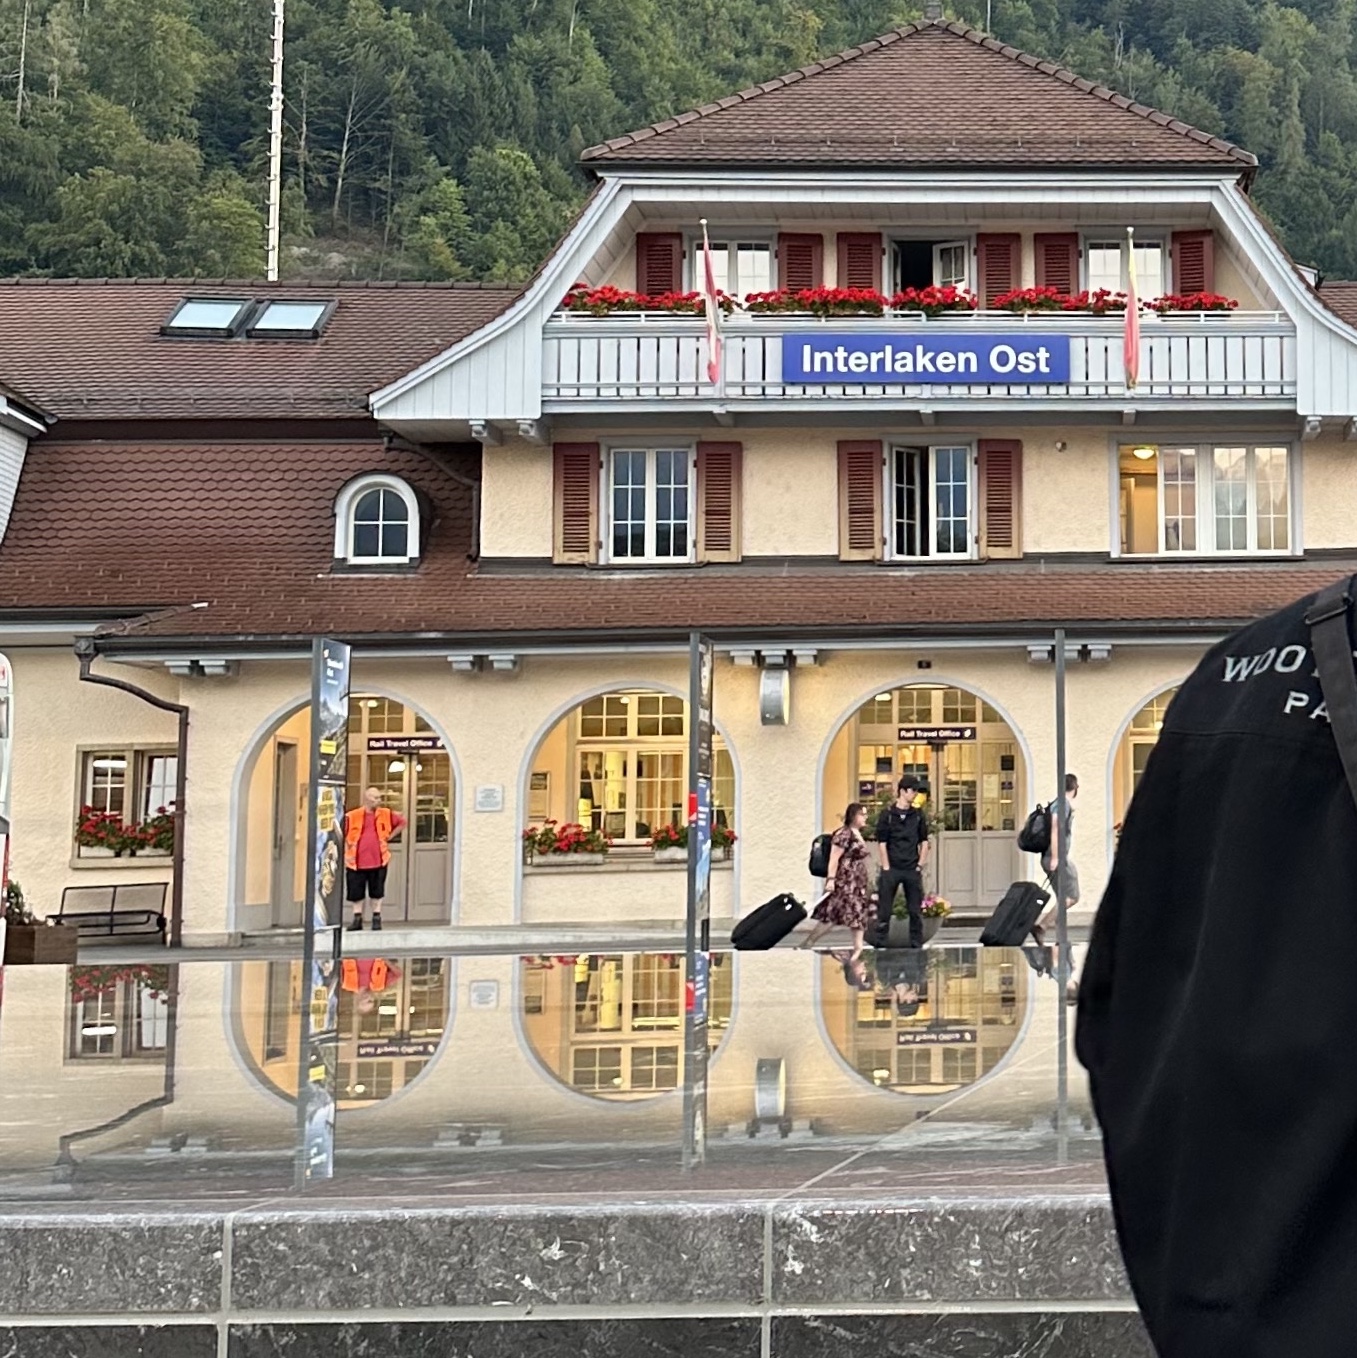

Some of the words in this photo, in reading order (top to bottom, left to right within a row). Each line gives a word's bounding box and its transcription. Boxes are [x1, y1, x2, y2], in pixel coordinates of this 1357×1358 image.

[802, 344, 978, 373] Interlaken
[989, 344, 1050, 374] Ost
[900, 730, 915, 738] Rail
[915, 730, 938, 738] Travel
[938, 729, 961, 738] Office
[369, 740, 385, 748] Rail
[385, 739, 409, 747] Travel
[409, 739, 433, 747] Office
